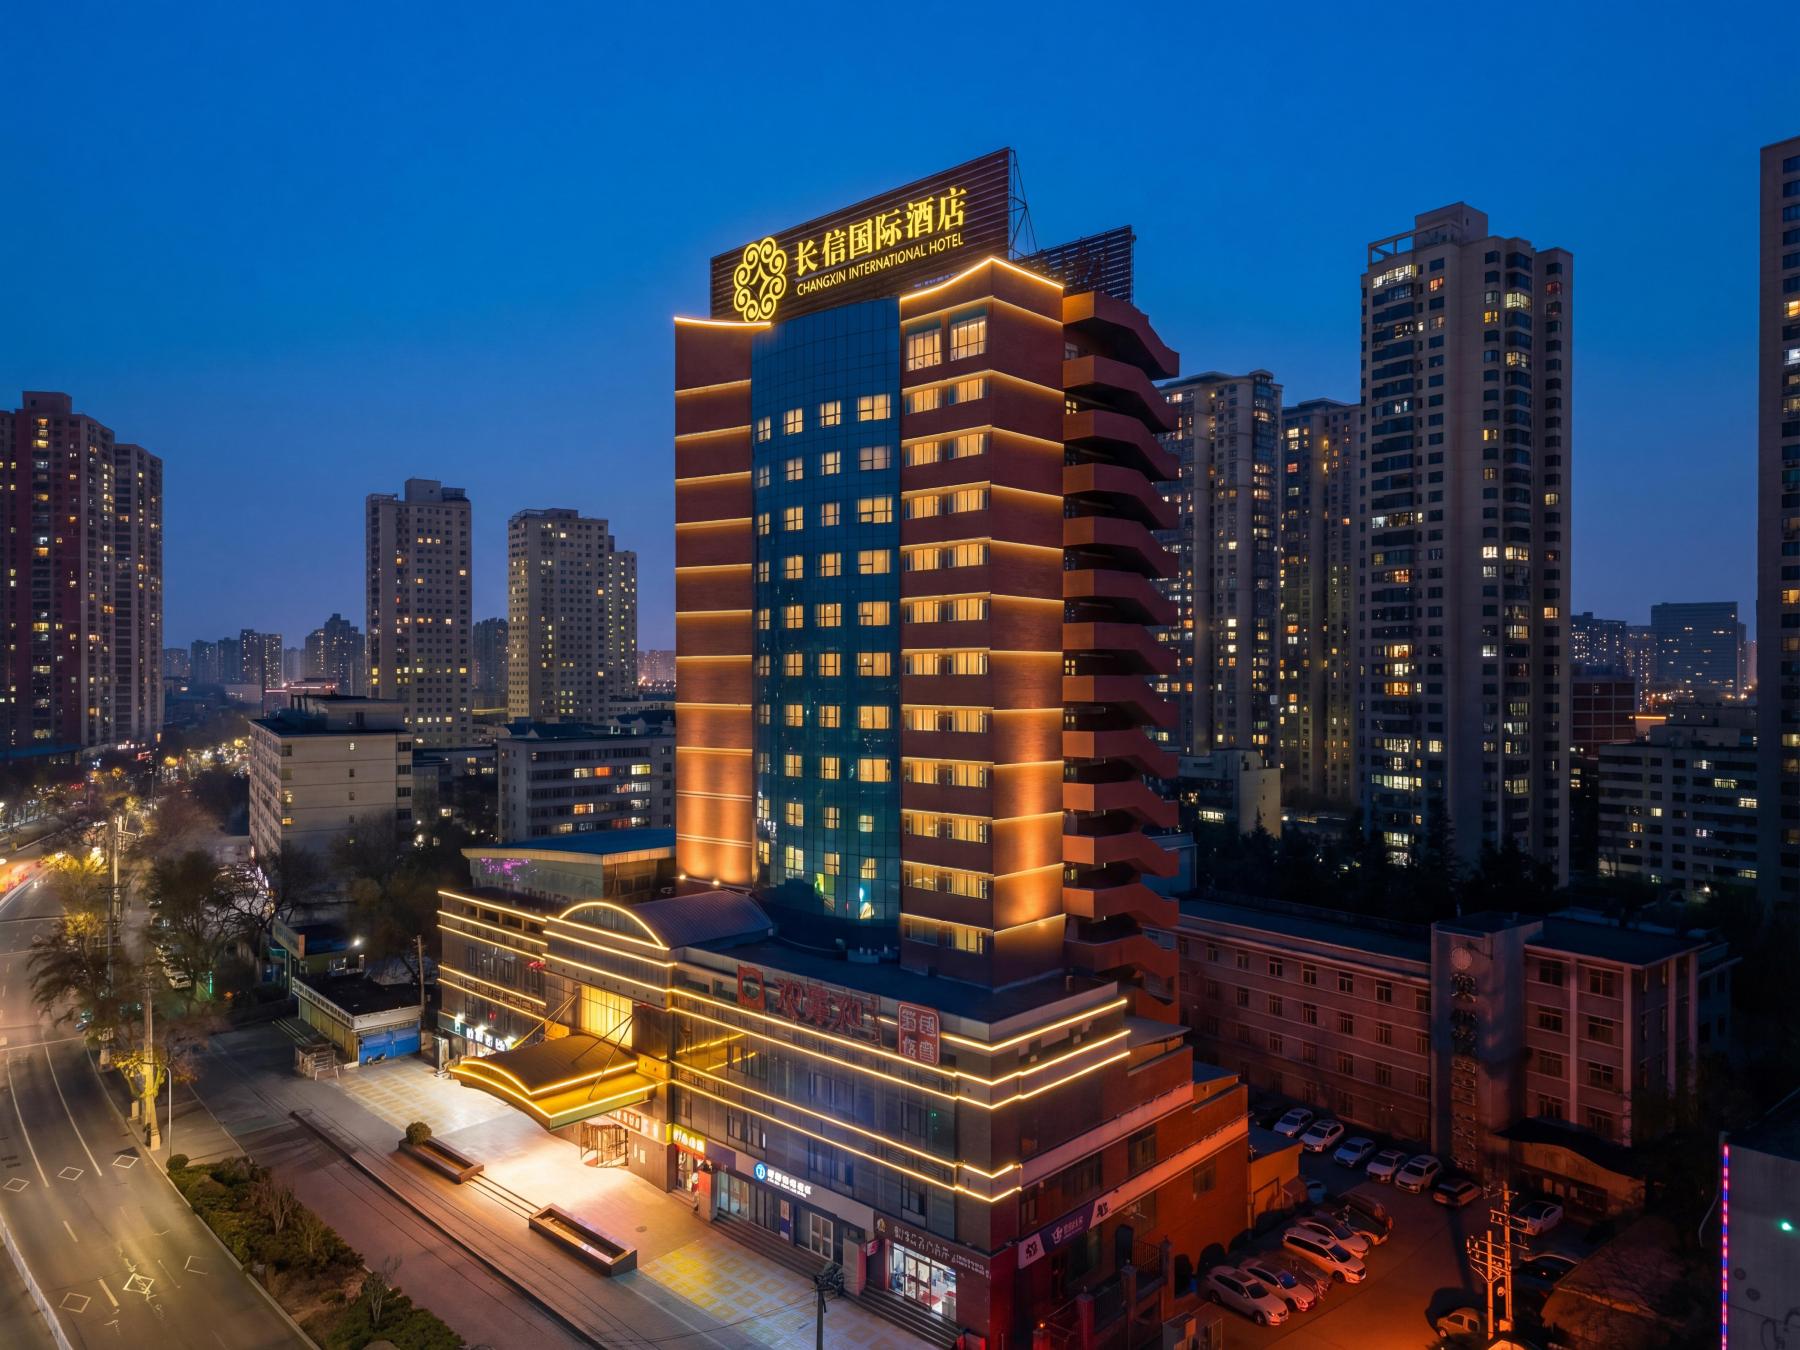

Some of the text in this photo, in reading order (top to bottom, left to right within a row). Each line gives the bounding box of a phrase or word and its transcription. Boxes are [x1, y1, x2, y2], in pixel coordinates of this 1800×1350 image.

[795, 186, 967, 276] 长信国际酒店
[797, 232, 964, 296] CHANGXIN INTERNATIONAL HOTEL
